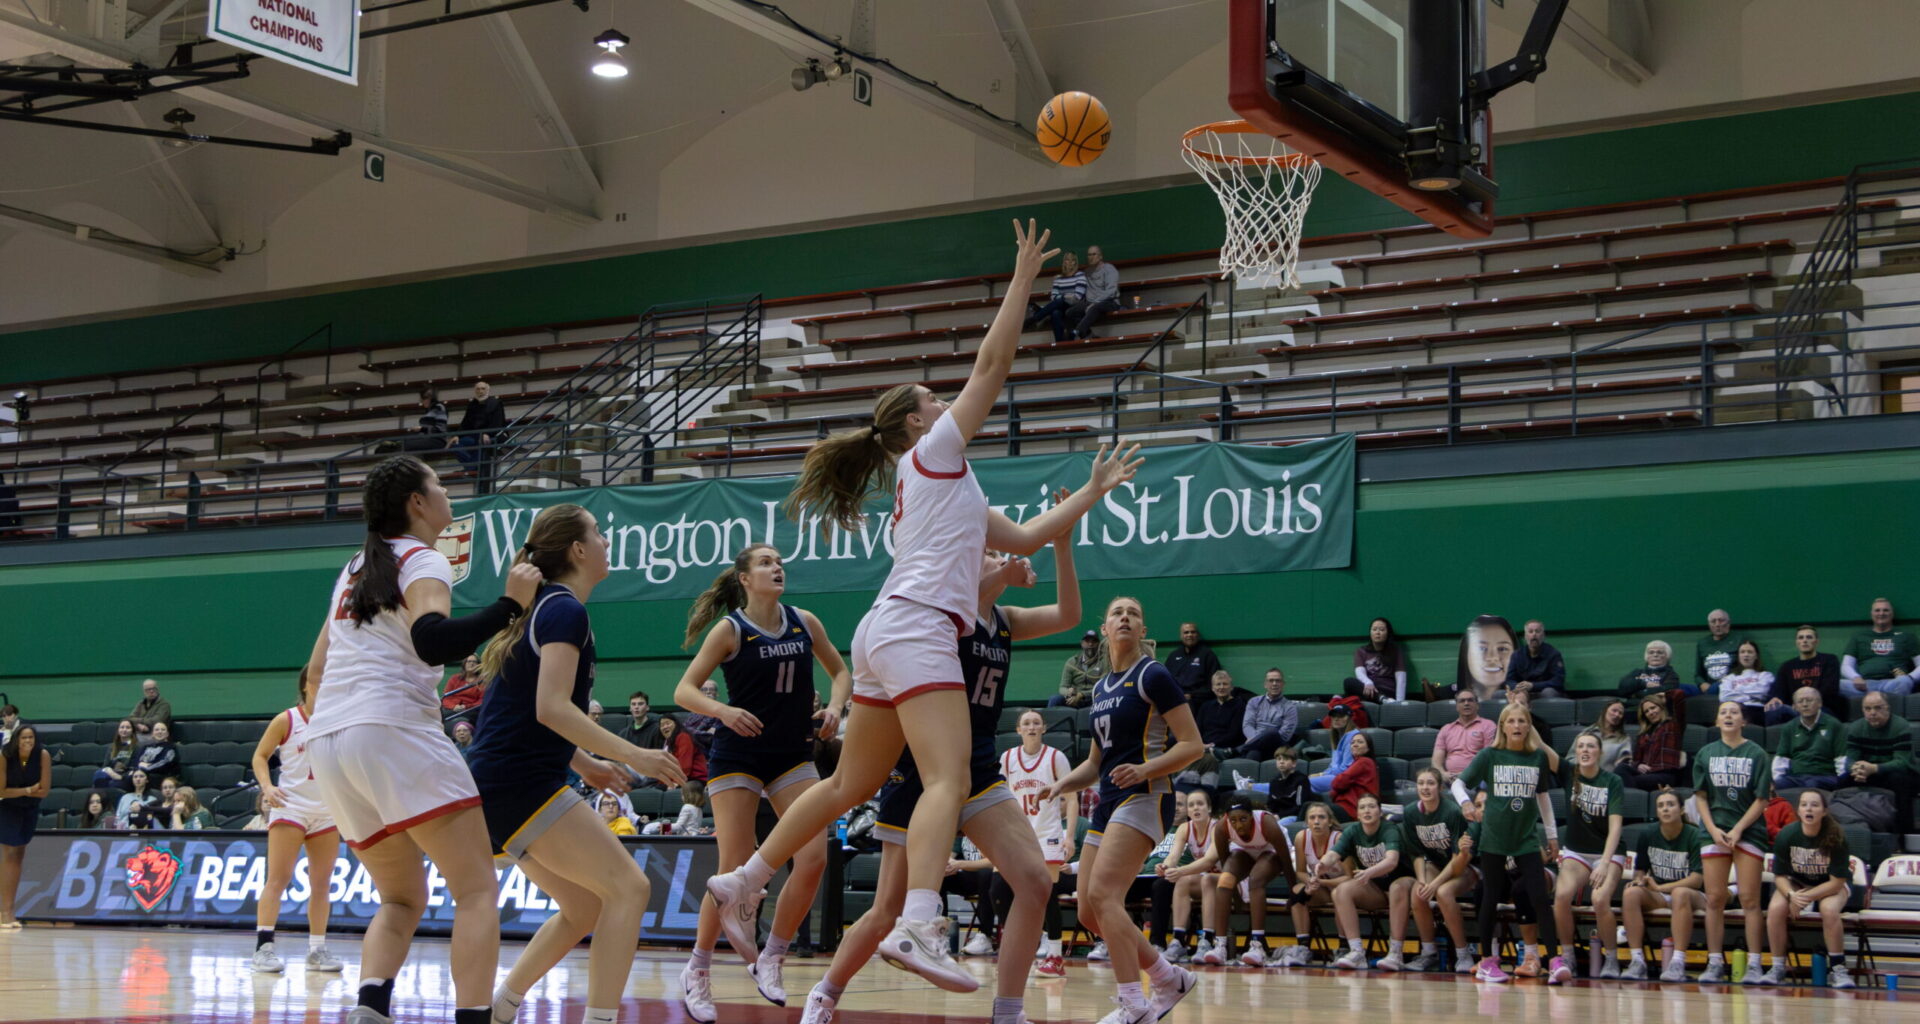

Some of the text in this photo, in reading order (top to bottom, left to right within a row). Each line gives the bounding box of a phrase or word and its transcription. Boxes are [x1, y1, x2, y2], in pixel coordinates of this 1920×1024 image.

[257, 0, 318, 27] NATIONAL
[250, 15, 323, 52] CHAMPIONS
[855, 73, 871, 103] D
[366, 154, 383, 180] C
[480, 507, 752, 584] Wington
[759, 641, 805, 659] EMORY
[972, 640, 1009, 664] EMORY
[775, 660, 796, 693] 11
[970, 665, 1004, 708] 15
[1088, 696, 1125, 716] EMORY
[1093, 714, 1113, 749] 12
[194, 856, 311, 903] BEAS
